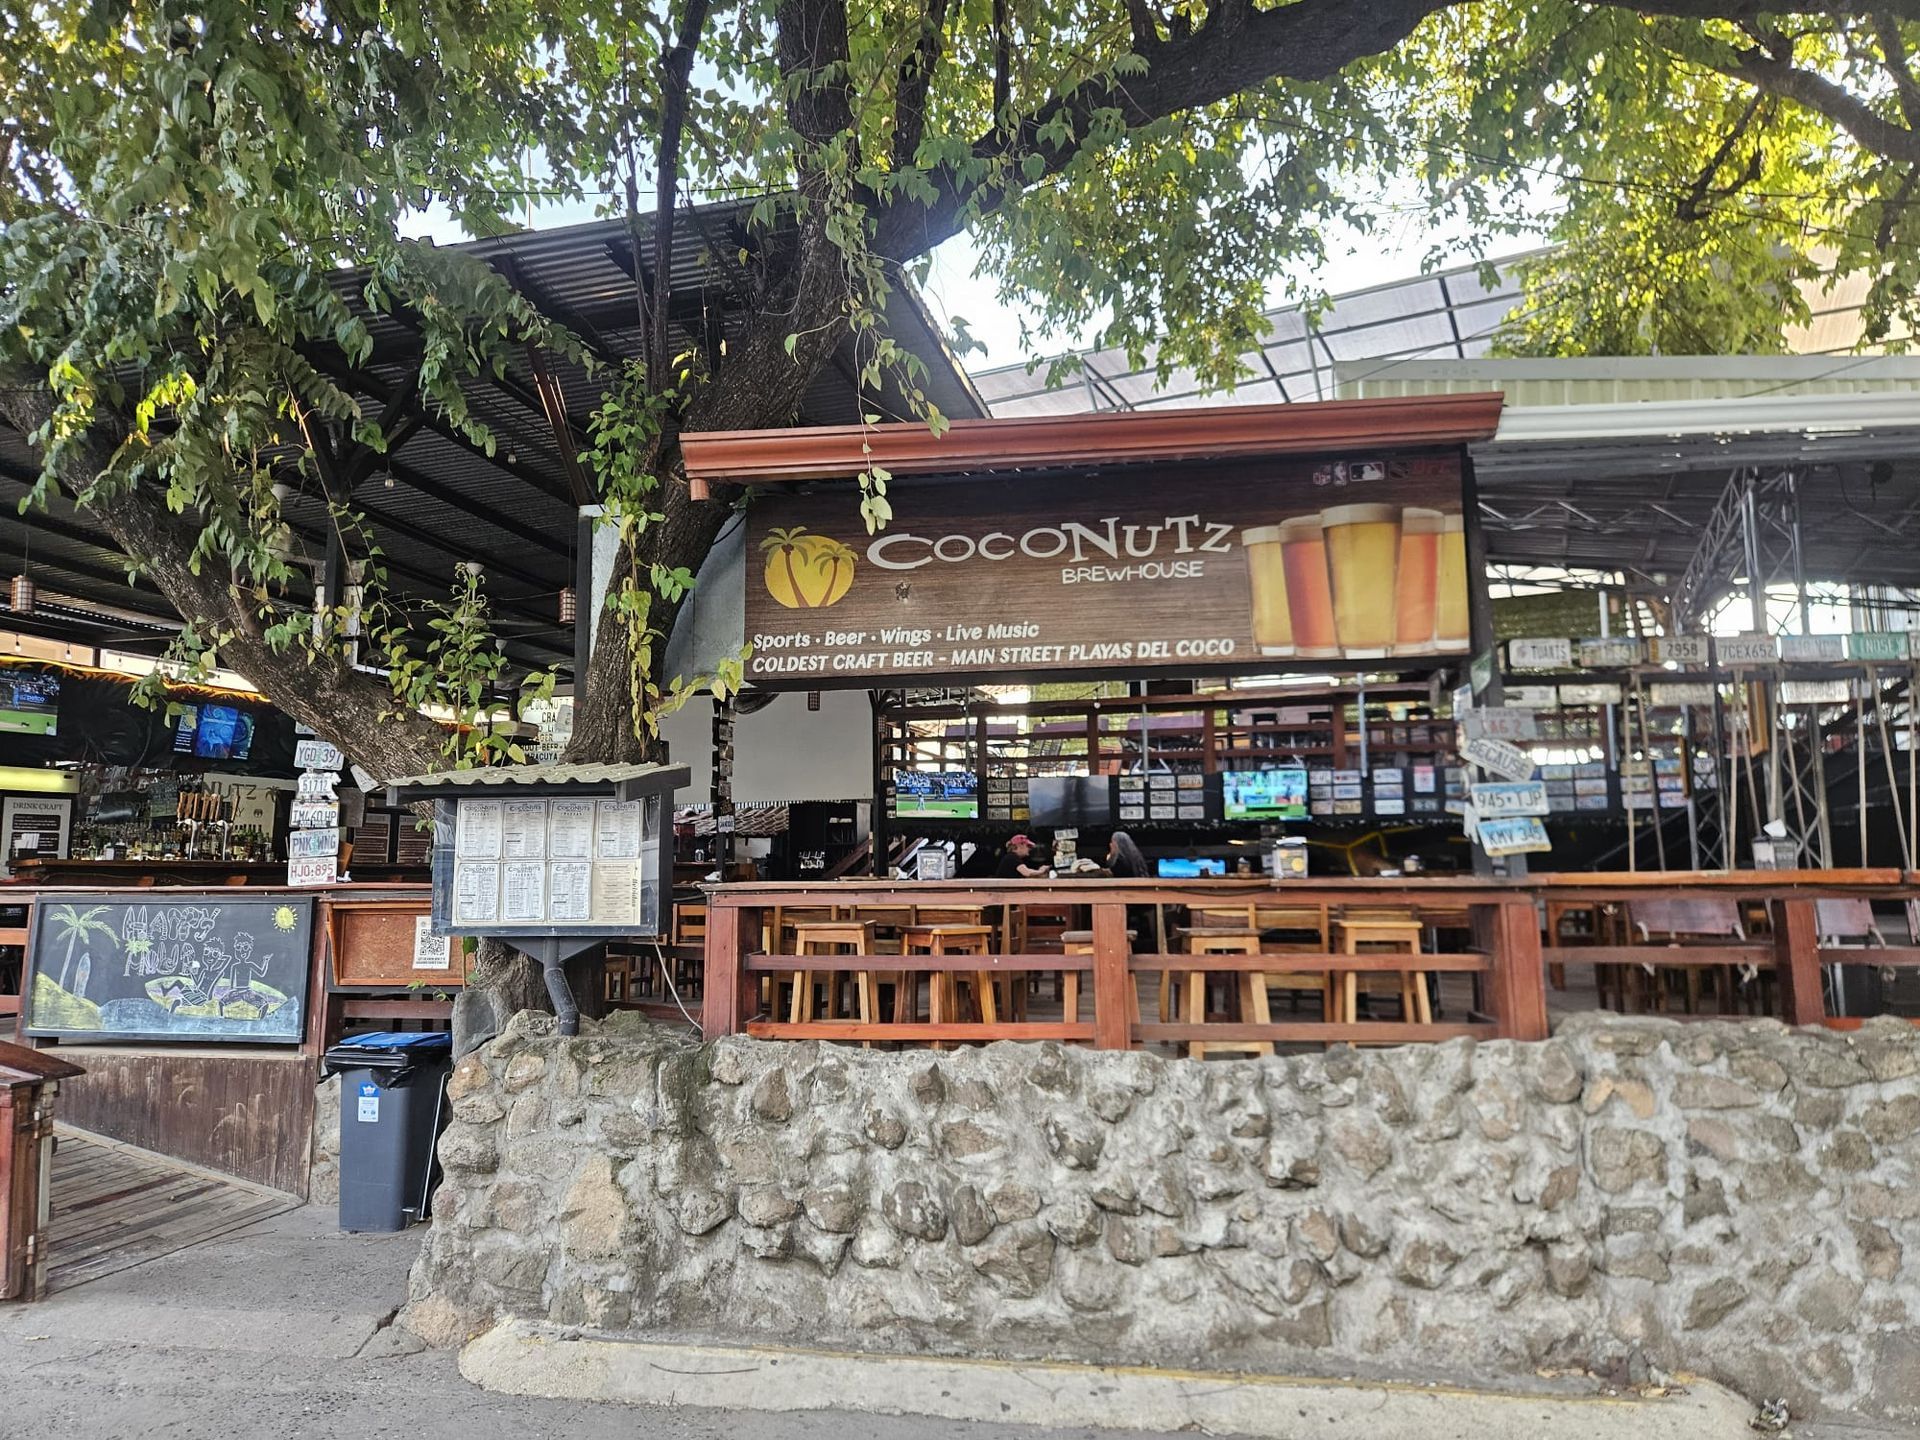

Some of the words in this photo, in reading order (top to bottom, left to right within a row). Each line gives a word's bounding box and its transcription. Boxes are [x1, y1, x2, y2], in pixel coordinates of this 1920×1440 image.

[1061, 560, 1205, 585] BREWHOUSE
[752, 631, 811, 652] Sports
[824, 630, 867, 647] Beer
[880, 626, 932, 647] Wings
[945, 624, 983, 642] Live
[987, 621, 1040, 640] Music
[752, 655, 829, 674] COLDEST
[832, 652, 888, 670] CRAFT
[892, 651, 934, 668] BEER
[950, 648, 995, 666] MAIN
[999, 645, 1065, 664] STREET
[1068, 642, 1133, 661] PLAYAS
[1137, 640, 1172, 659] DEL
[1175, 638, 1236, 658] COCO
[1667, 643, 1699, 657] 2958
[1721, 643, 1775, 659] 7CEX652
[298, 747, 317, 764] YGD
[1467, 740, 1528, 779] BECAUSE
[1476, 792, 1506, 808] 945
[292, 837, 312, 854] PNK
[317, 835, 336, 852] WNG
[1486, 830, 1514, 845] KMV
[122, 905, 222, 942] HAPPY
